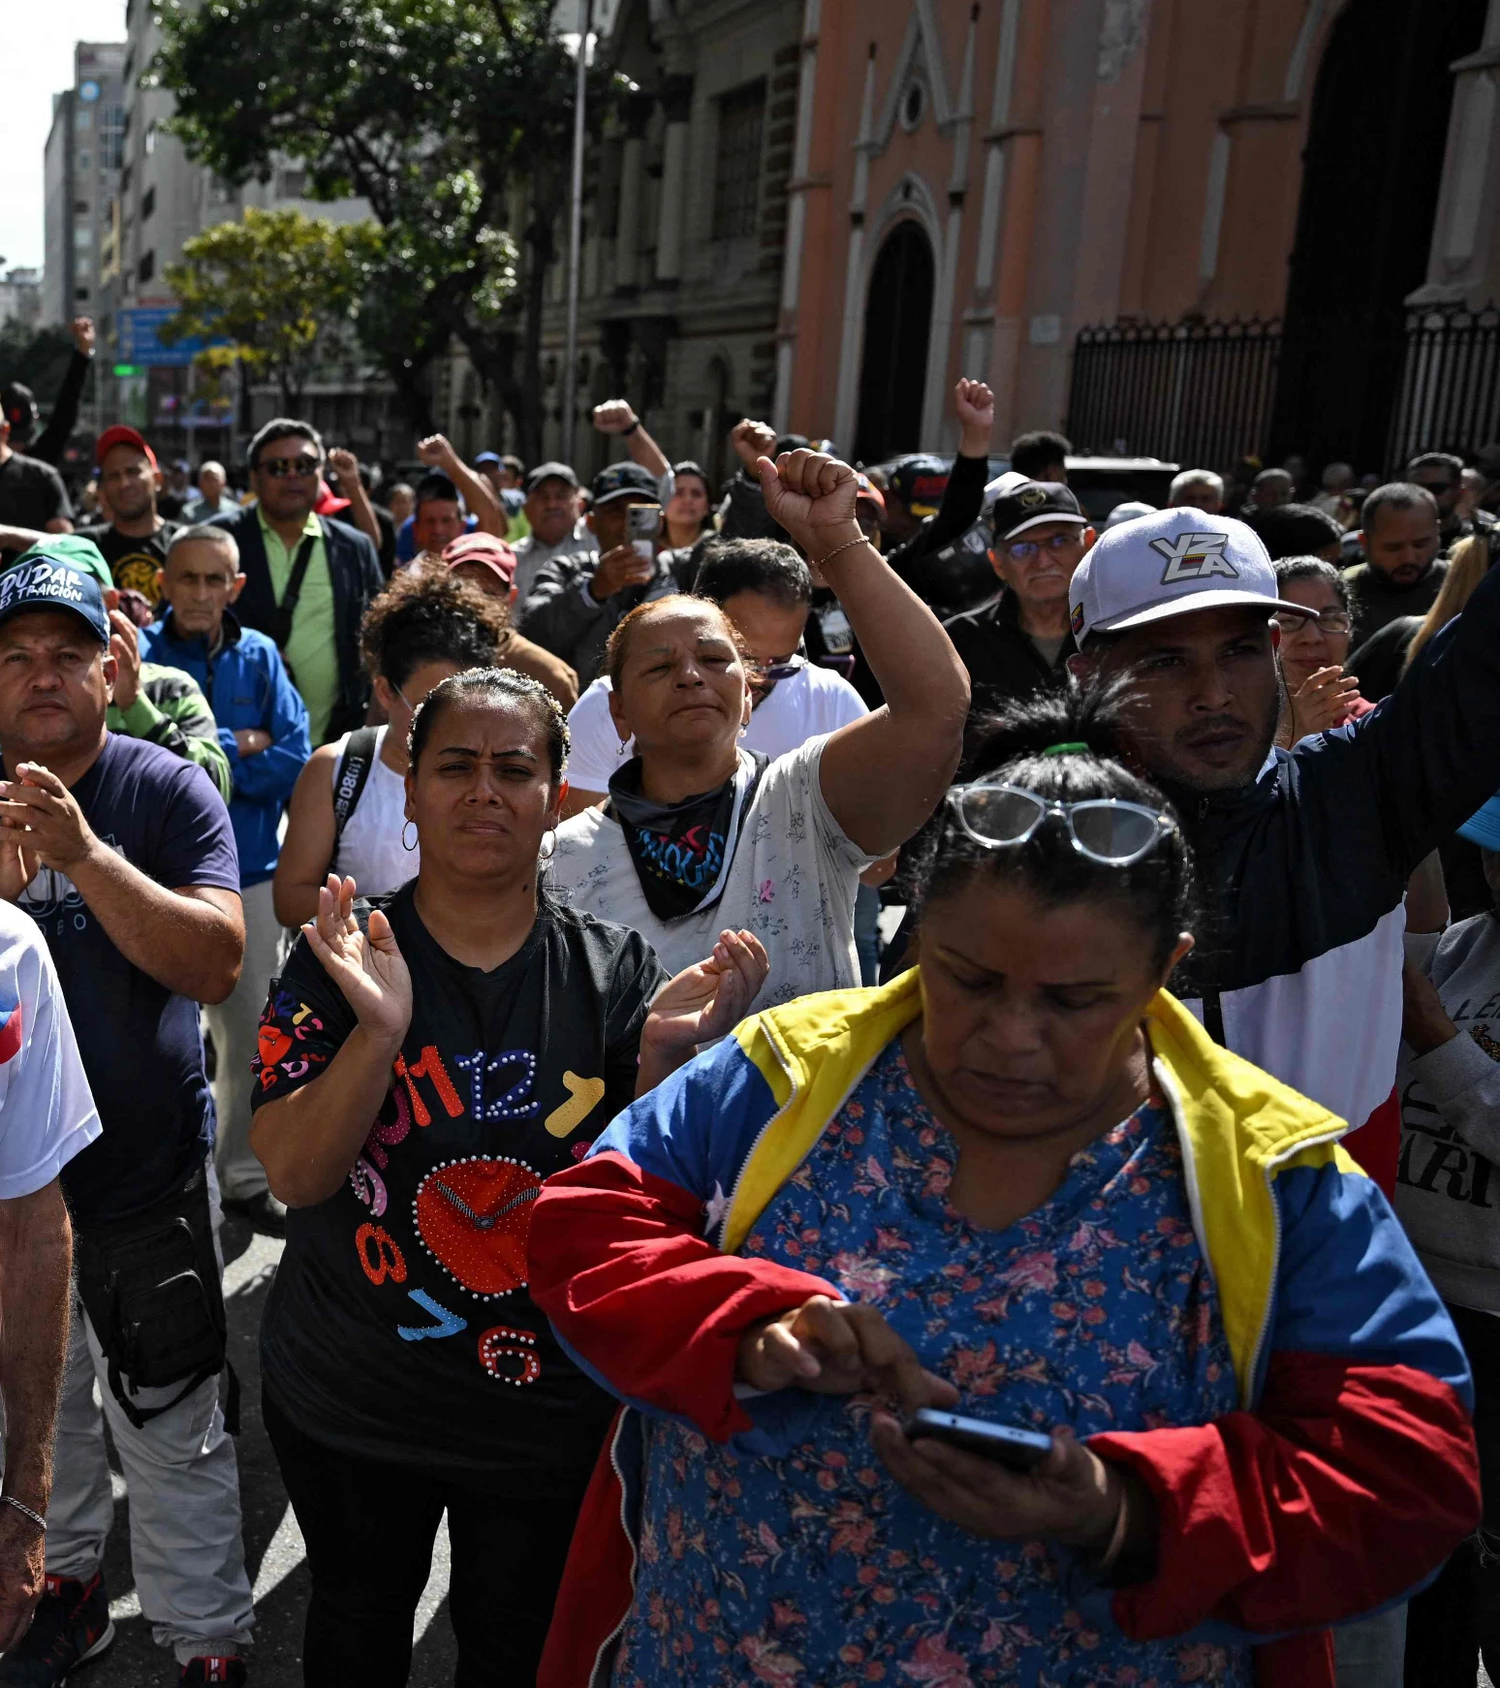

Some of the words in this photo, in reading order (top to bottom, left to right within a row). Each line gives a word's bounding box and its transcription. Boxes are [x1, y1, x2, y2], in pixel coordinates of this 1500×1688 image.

[0, 563, 82, 597] DUDAR
[0, 592, 14, 610] ES
[17, 582, 82, 602] TRAICIÓN
[454, 1049, 542, 1123] 12
[355, 1222, 407, 1285] 8
[397, 1287, 468, 1341] 7
[478, 1325, 541, 1386] 6
